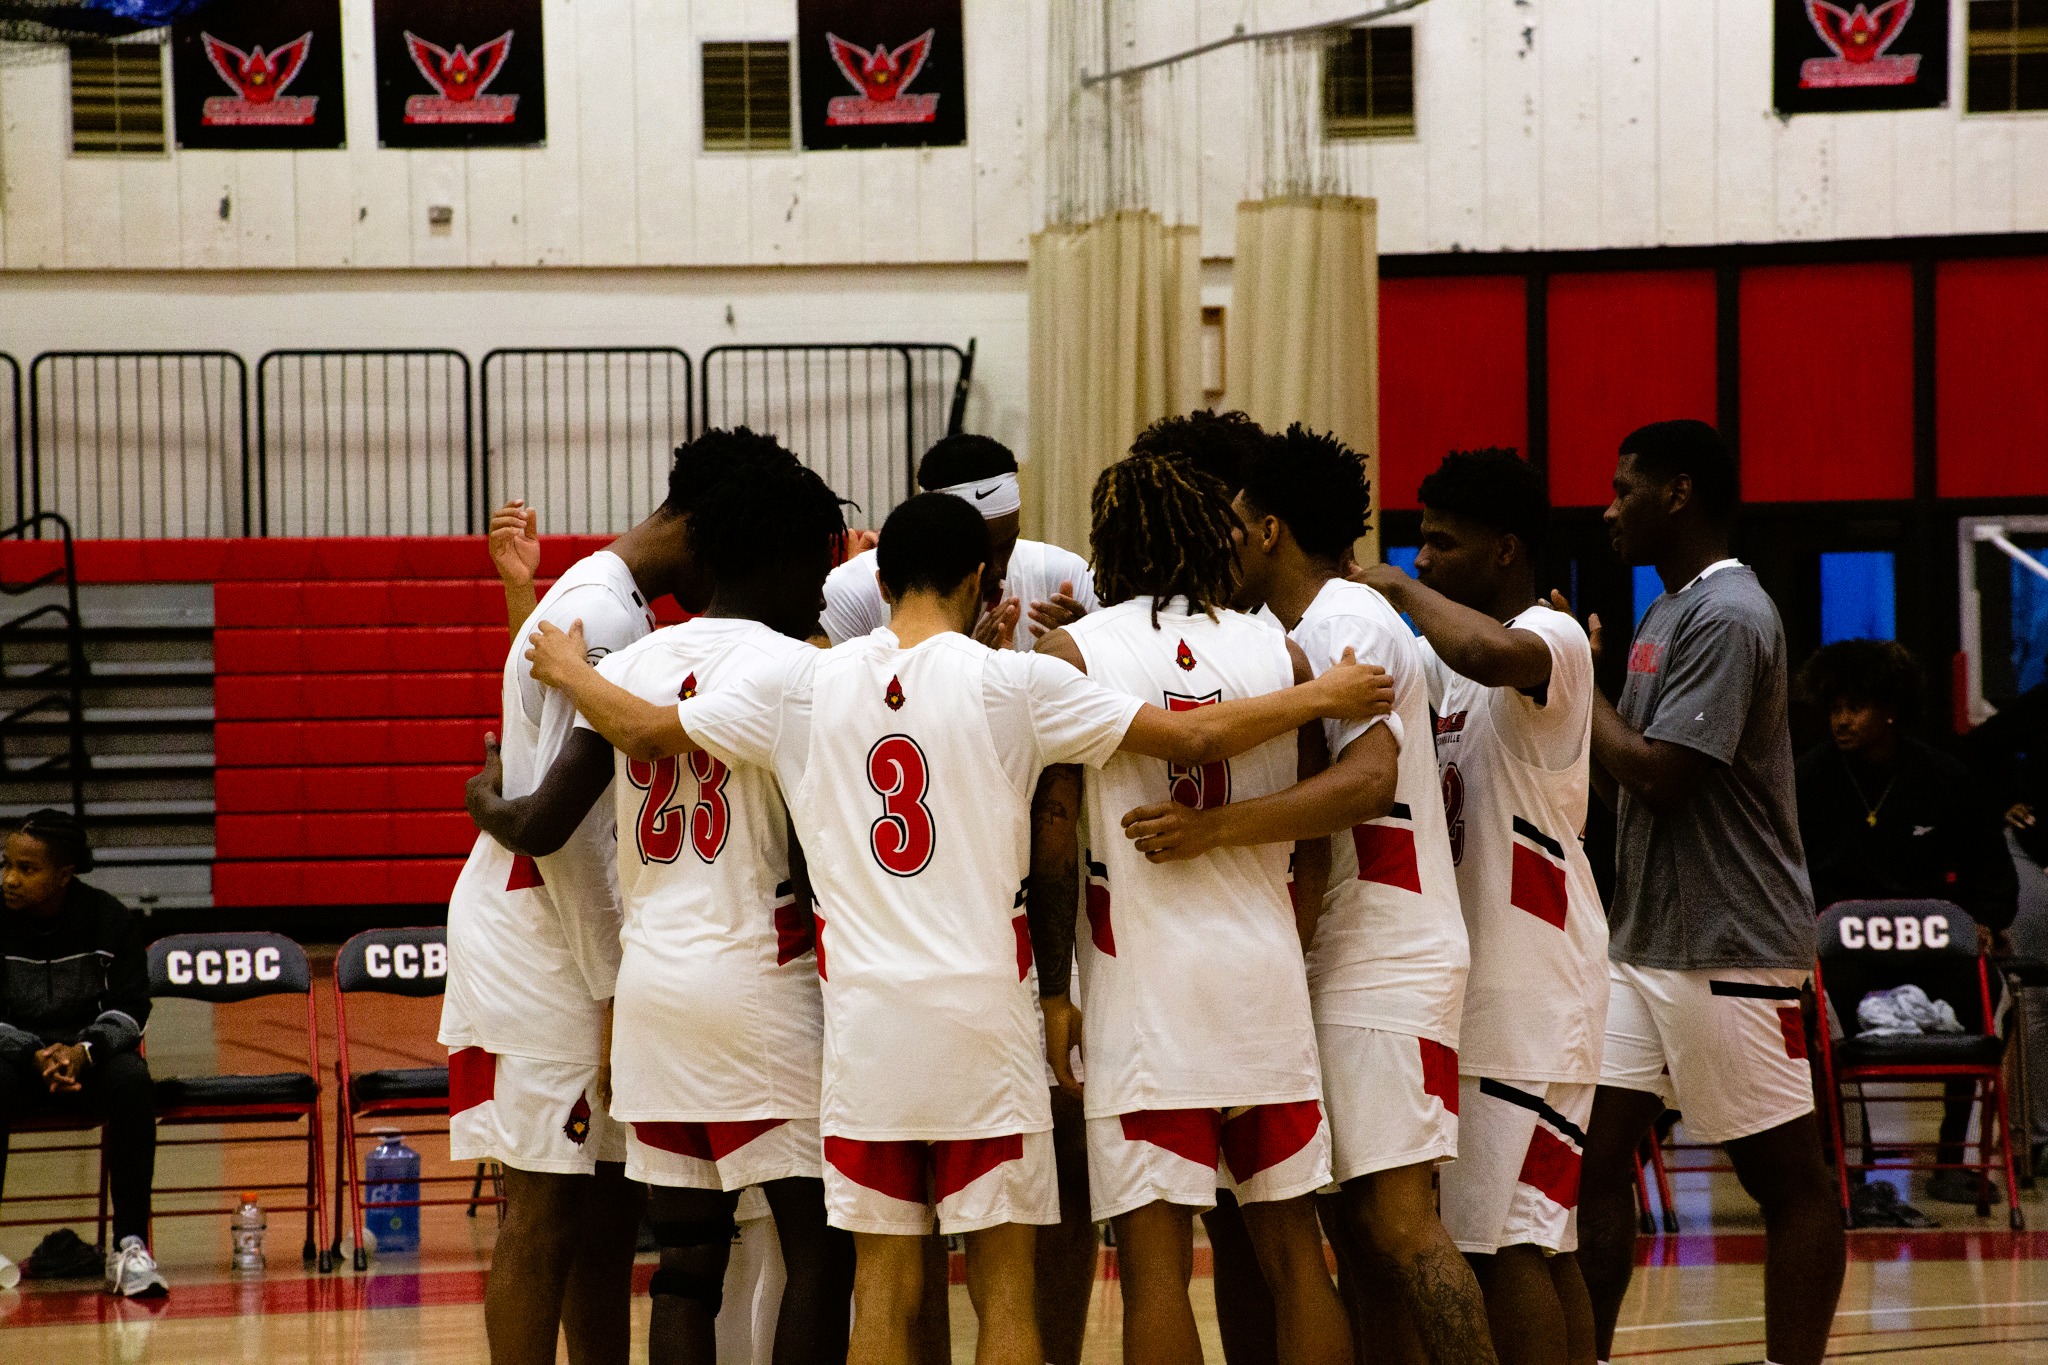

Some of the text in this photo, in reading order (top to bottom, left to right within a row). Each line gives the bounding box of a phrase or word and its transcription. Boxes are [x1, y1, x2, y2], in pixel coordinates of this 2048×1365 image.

[626, 751, 731, 865] 23
[867, 733, 936, 878] 3
[1839, 915, 1950, 951] CCBC
[167, 947, 280, 986] CCBC
[365, 942, 448, 979] CCB
